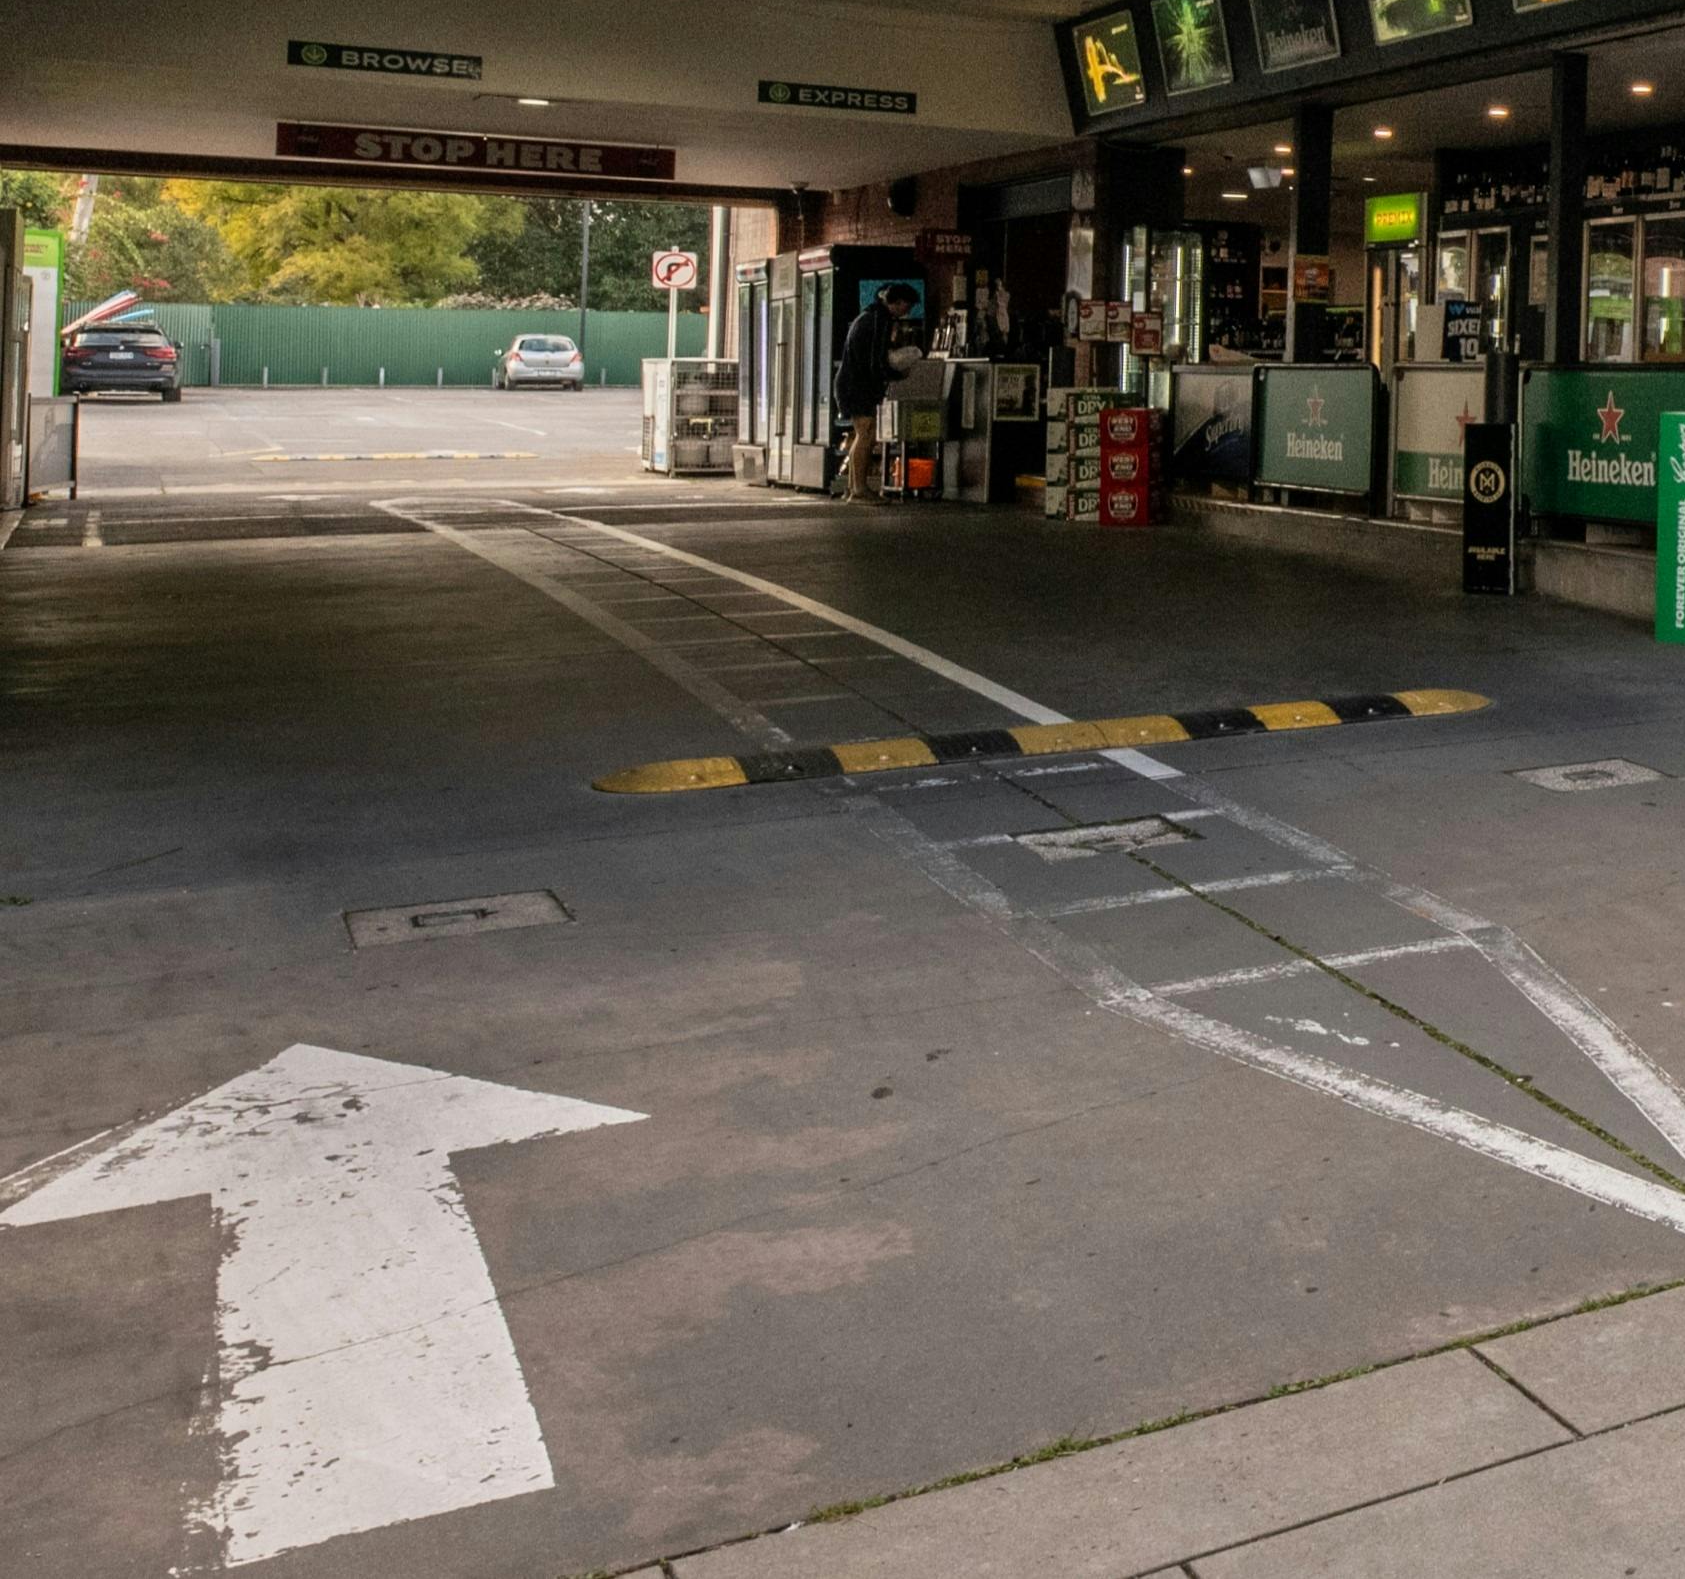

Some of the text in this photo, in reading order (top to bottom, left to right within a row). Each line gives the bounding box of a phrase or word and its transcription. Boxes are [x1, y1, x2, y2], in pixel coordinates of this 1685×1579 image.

[341, 50, 469, 75] BROWSE
[799, 89, 908, 110] EXPRESS
[354, 132, 604, 172] STOP HERE
[1078, 401, 1106, 415] DRY
[1079, 433, 1099, 448] DR
[1287, 432, 1344, 461] Heineken
[1079, 465, 1099, 480] DR
[1428, 458, 1464, 491] Hein
[1568, 450, 1656, 487] Heineken
[1078, 498, 1099, 513] DR
